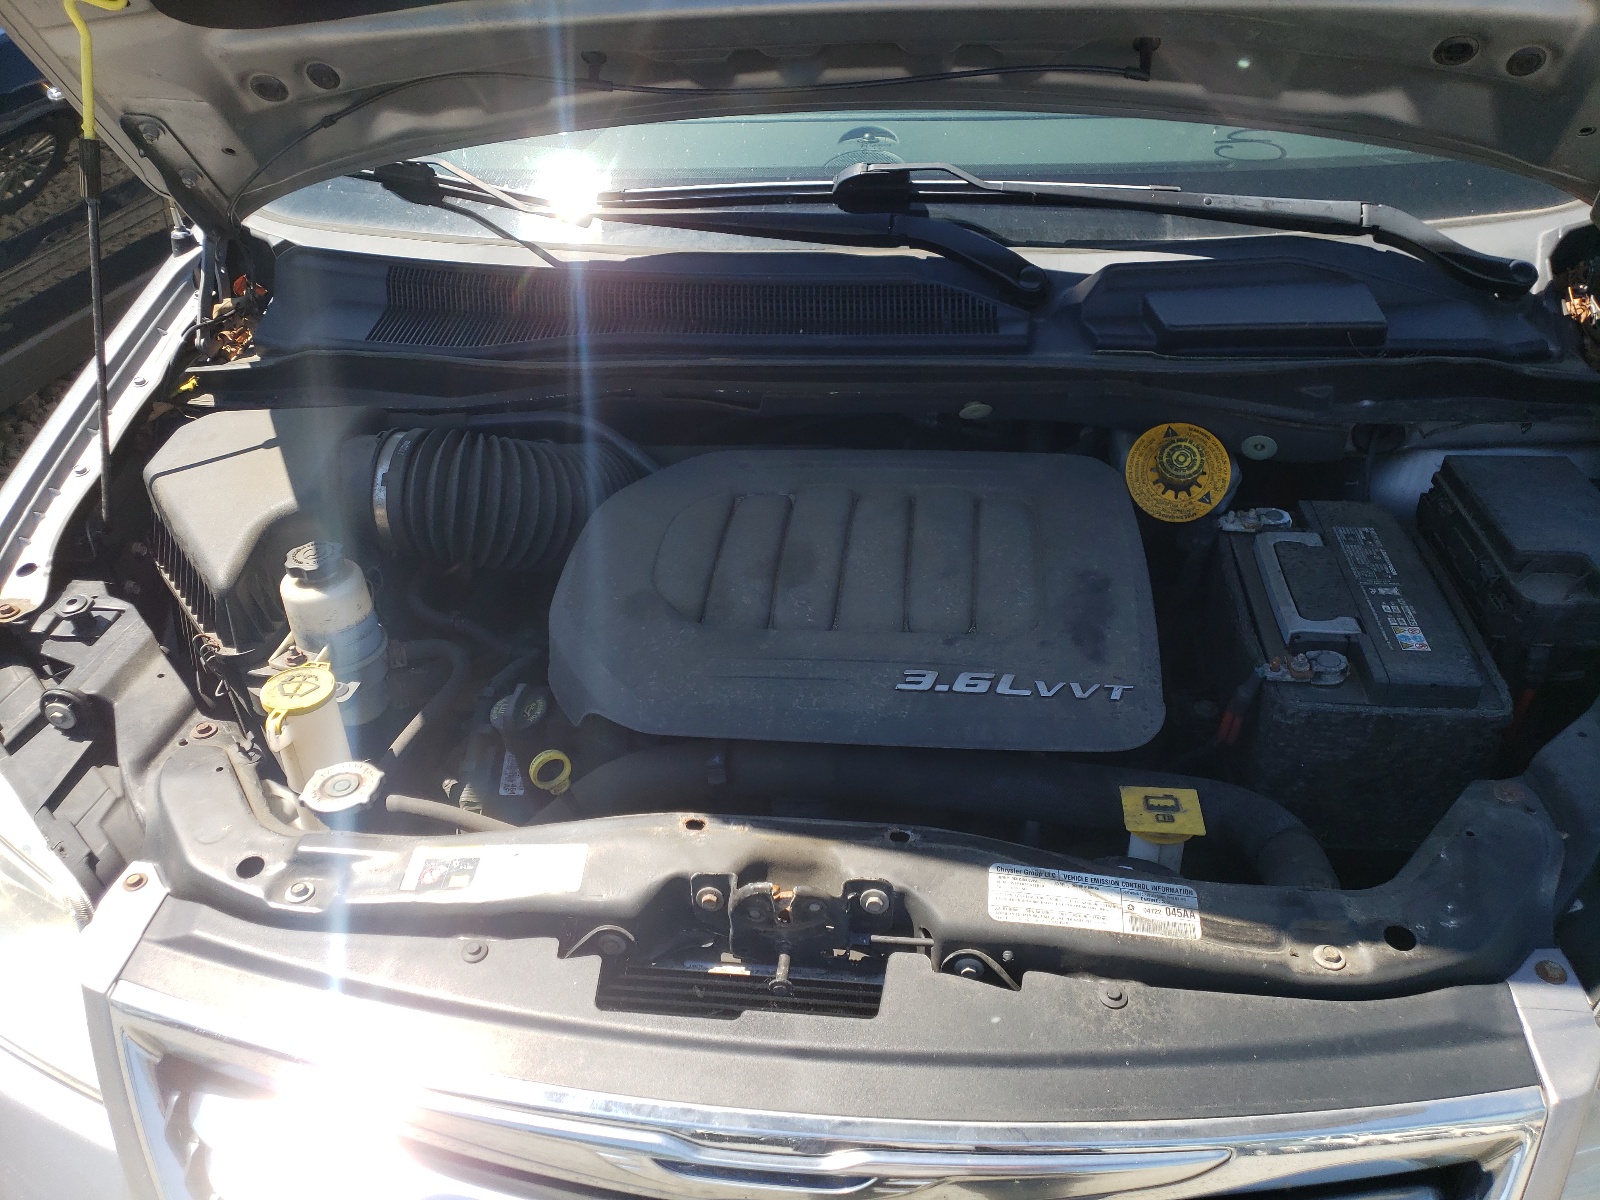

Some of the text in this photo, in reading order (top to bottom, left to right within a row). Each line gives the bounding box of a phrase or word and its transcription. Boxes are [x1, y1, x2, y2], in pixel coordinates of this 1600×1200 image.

[996, 865, 1057, 879] Chrysler Group LLC
[1063, 873, 1089, 883] VEHICLE
[1090, 876, 1120, 887] EMISSION
[1121, 881, 1150, 891] CONTROL
[1151, 885, 1194, 896] INFORMATION
[1165, 906, 1196, 919] 045AA
